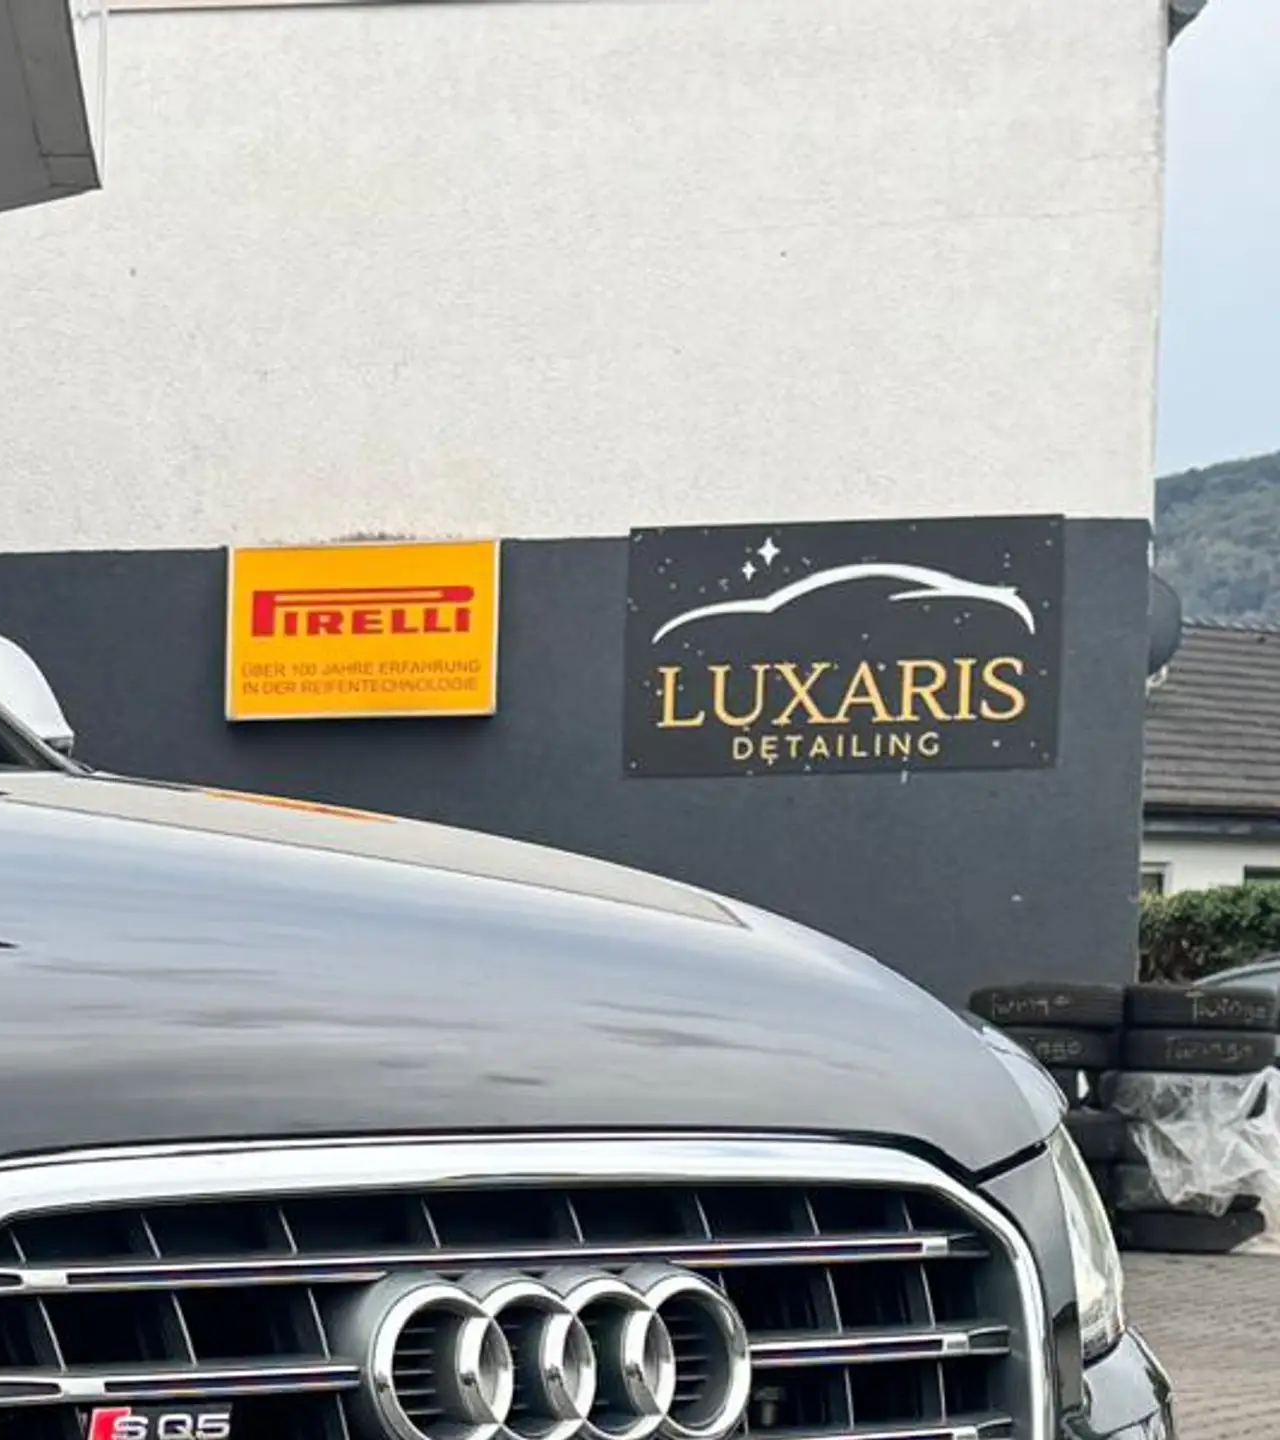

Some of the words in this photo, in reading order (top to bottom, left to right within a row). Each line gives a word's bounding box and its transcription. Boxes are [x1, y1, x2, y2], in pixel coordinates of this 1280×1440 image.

[251, 585, 475, 637] PIRELLI
[242, 661, 286, 678] ÜBER
[291, 662, 317, 676] 100
[322, 660, 373, 676] JAHRE
[378, 658, 481, 675] ERFAHRUNG
[242, 682, 259, 695] IN
[263, 680, 296, 695] DER
[301, 677, 478, 693] REIFENTECHNOLOGIE
[657, 656, 1027, 728] LUXARIS
[732, 731, 940, 761] DETAILING
